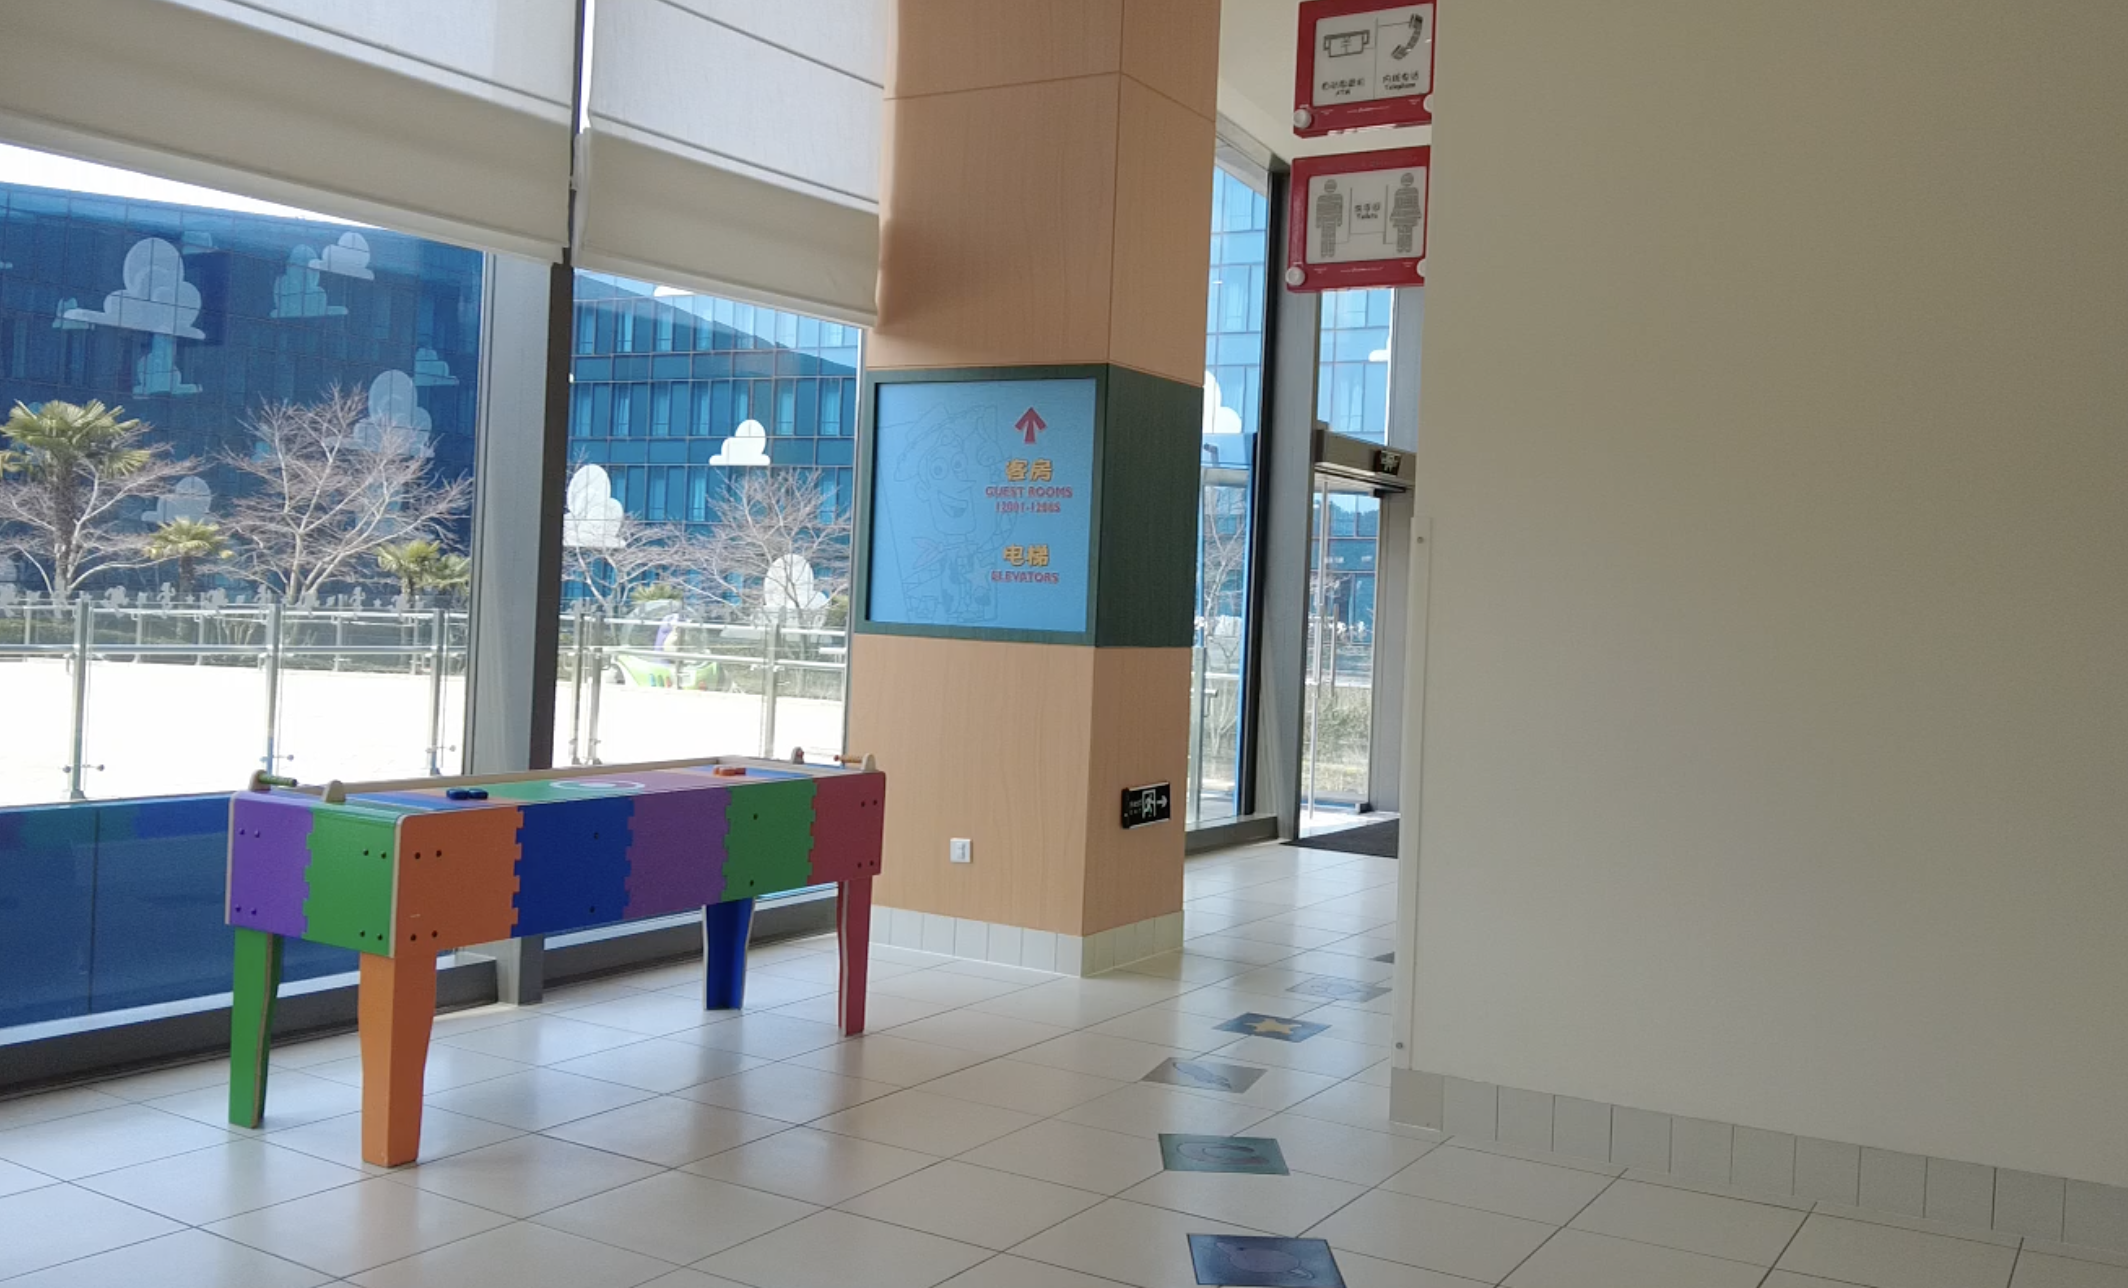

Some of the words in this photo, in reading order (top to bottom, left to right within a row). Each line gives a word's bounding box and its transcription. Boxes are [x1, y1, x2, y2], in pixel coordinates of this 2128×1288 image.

[1005, 458, 1053, 481] 客房
[985, 486, 1025, 498] GUEST
[1028, 486, 1073, 499] ROOMS
[1003, 543, 1050, 567] 电梯
[991, 570, 1059, 584] ELEVATORS
